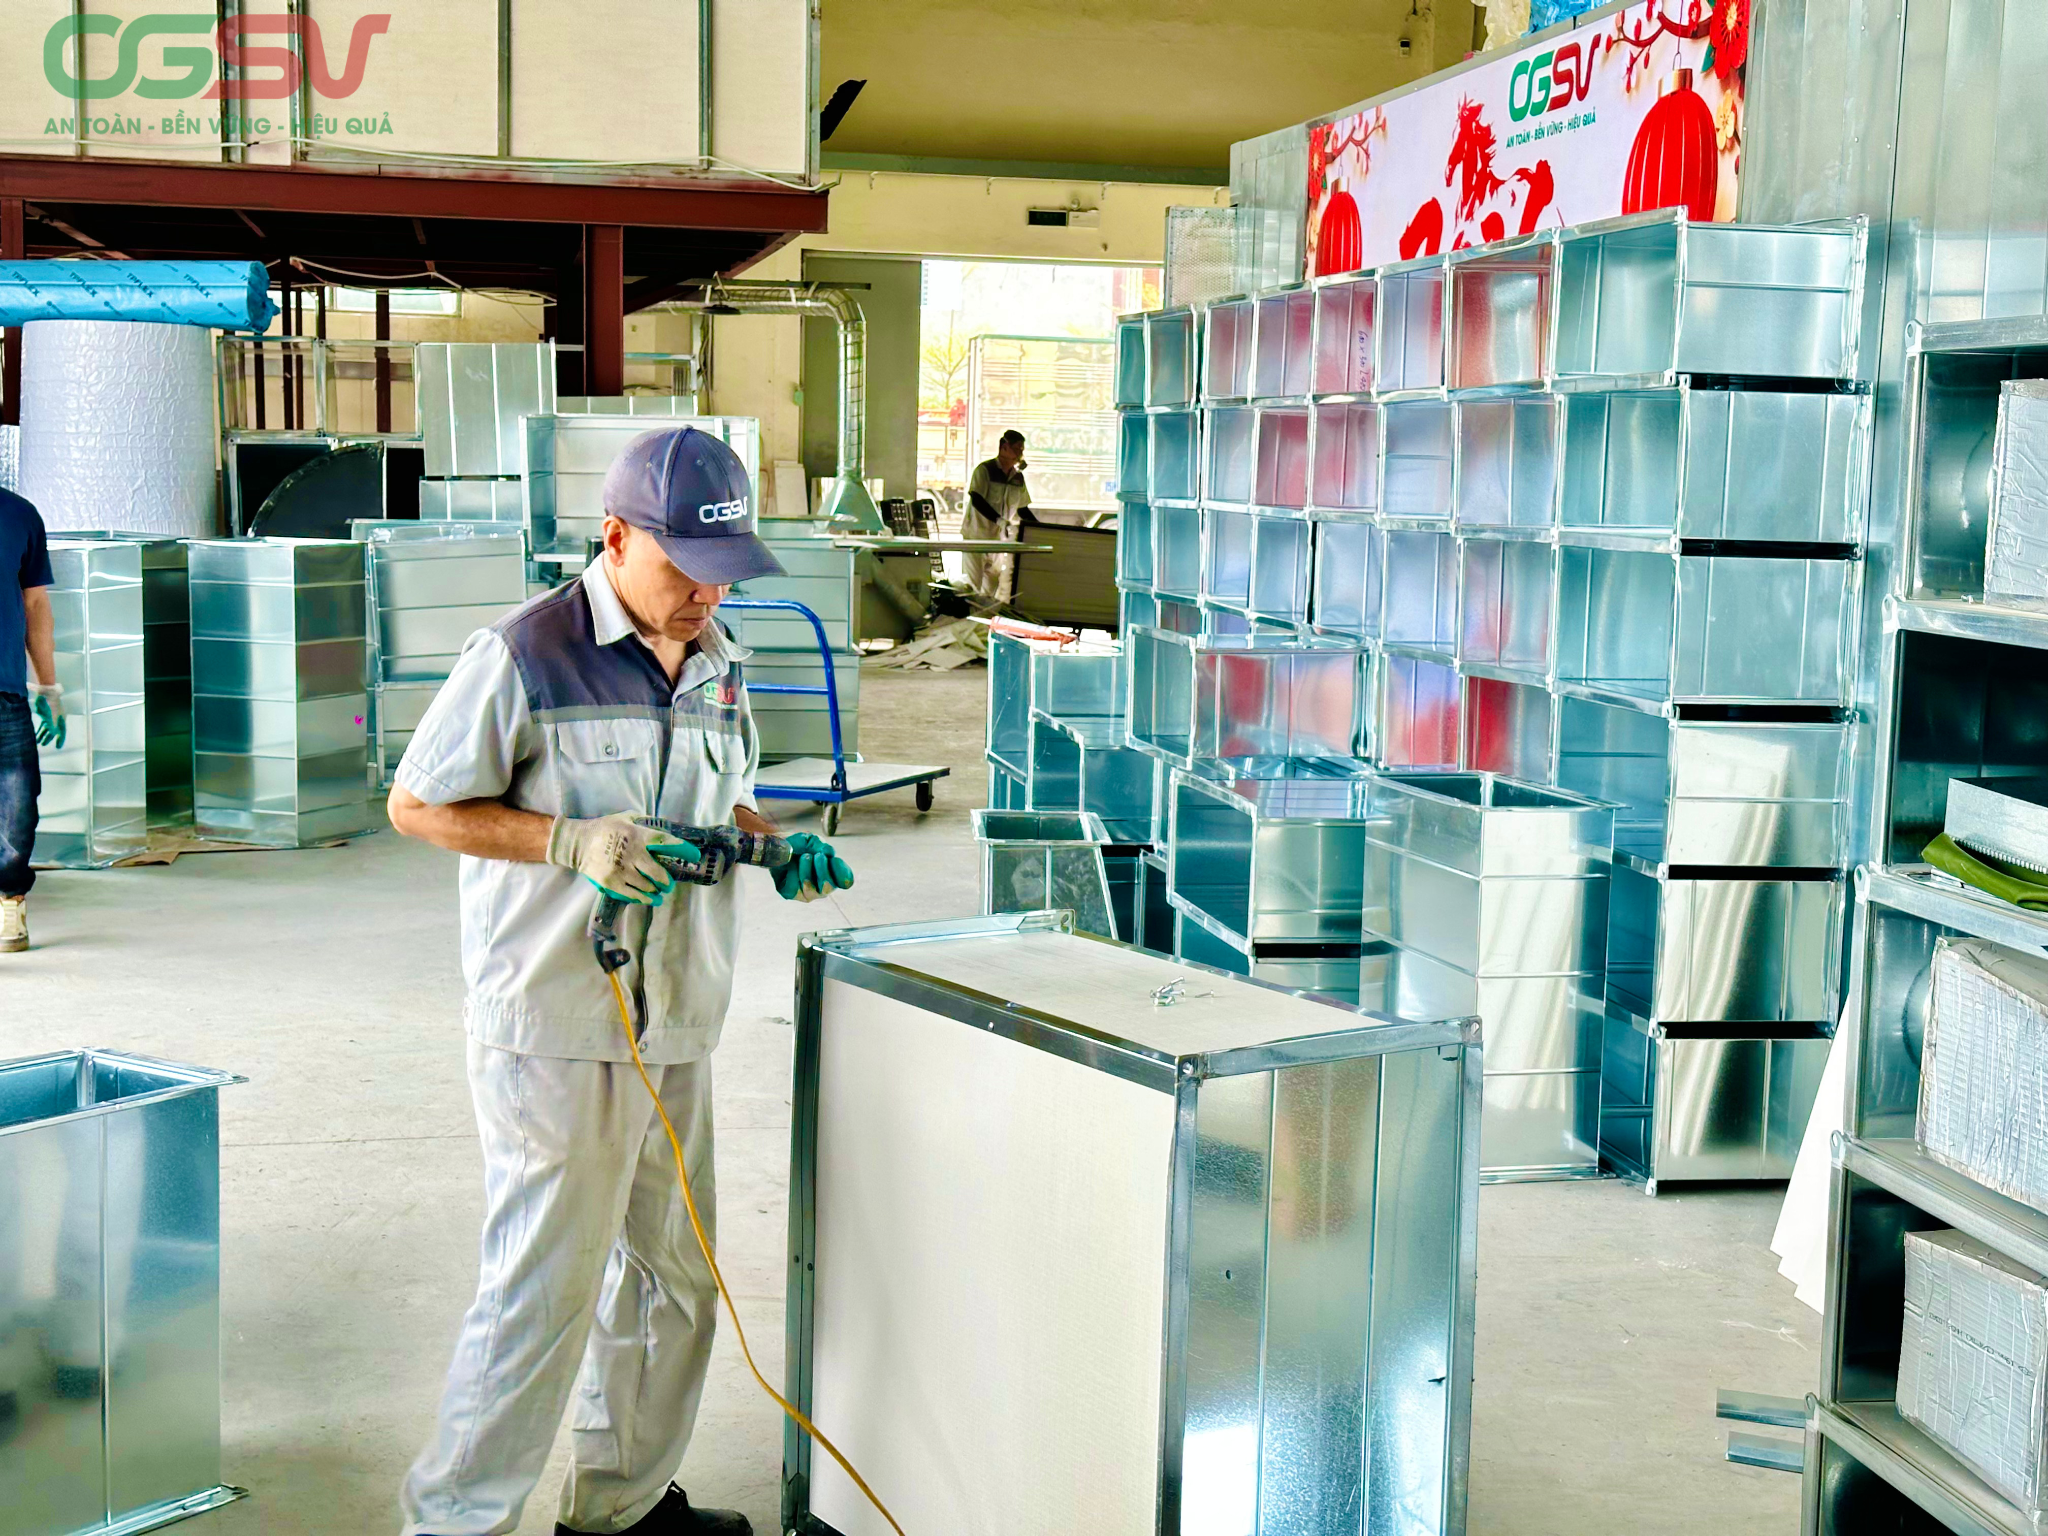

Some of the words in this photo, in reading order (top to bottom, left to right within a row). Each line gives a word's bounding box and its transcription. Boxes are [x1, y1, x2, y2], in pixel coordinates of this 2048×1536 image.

[1506, 135, 1515, 149] AN
[1516, 129, 1530, 146] TOÀN
[1582, 106, 1596, 127] QUẢ
